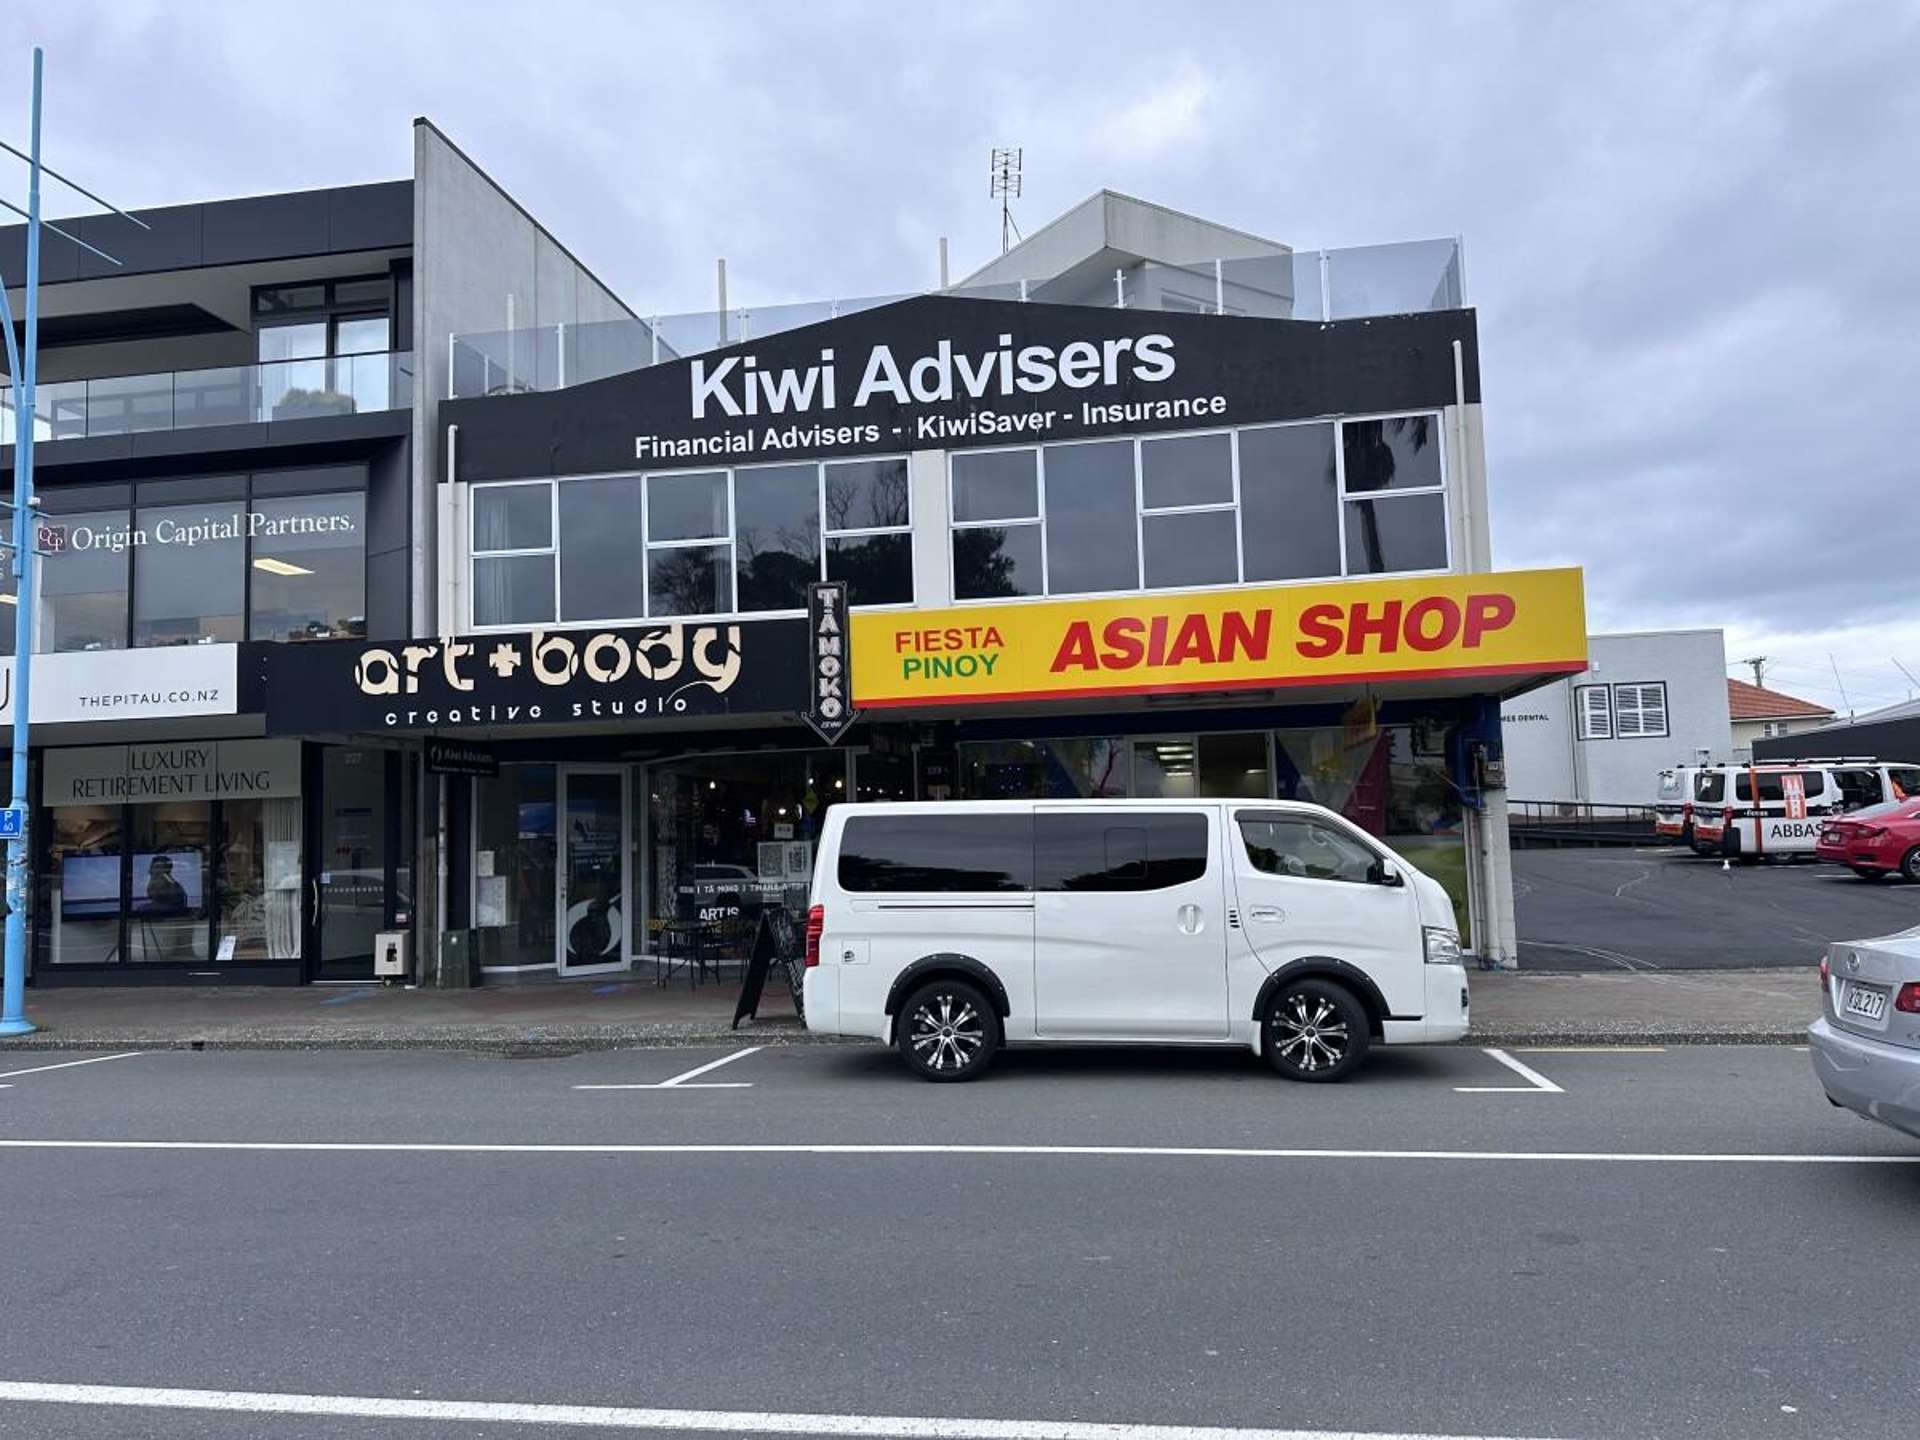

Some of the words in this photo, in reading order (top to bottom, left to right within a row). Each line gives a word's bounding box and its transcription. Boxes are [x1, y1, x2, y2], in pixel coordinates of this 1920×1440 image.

[690, 348, 836, 419] Kiwi
[854, 334, 1176, 407] Advisers
[635, 428, 754, 459] Financial
[762, 424, 880, 451] Advisers
[917, 409, 1057, 439] KiwiSaver
[1082, 397, 1227, 425] Insurance
[71, 524, 148, 552] Origin
[155, 513, 240, 547] Capital
[249, 513, 355, 537] Partners.
[895, 626, 1004, 653] FIESTA
[1050, 609, 1273, 673] ASIAN
[1295, 593, 1516, 659] SHOP
[354, 636, 475, 695] art
[531, 623, 742, 693] body
[903, 655, 1001, 680] PINOY
[79, 689, 219, 707] THEPITAU.CO.NZ
[385, 704, 541, 725] creative
[573, 697, 687, 716] studio
[1518, 713, 1550, 723] DENTAL
[130, 747, 211, 772] LUXURY
[72, 773, 199, 799] RETIREMENT
[204, 770, 271, 793] LIVING
[4, 810, 13, 822] P
[700, 908, 723, 921] ART
